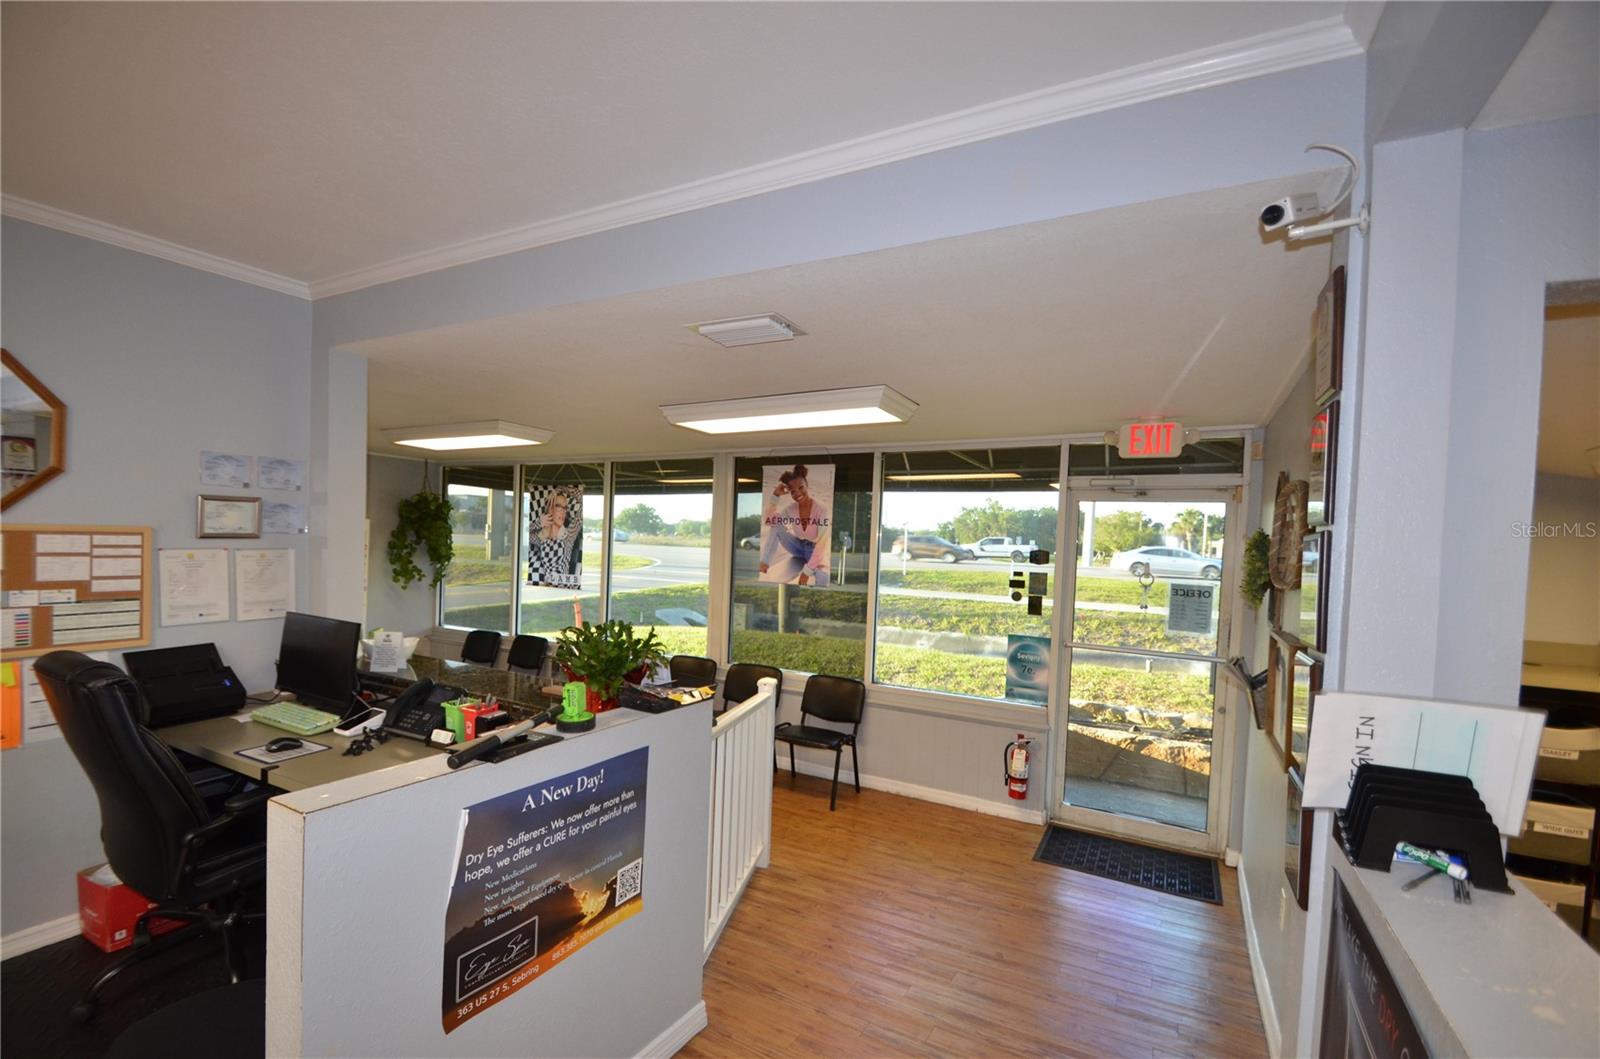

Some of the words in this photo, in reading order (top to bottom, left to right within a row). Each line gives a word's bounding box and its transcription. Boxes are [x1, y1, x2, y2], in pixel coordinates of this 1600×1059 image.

[1129, 422, 1177, 457] EXIT
[1355, 716, 1375, 740] IN
[522, 794, 536, 812] A
[540, 785, 573, 805] New
[577, 768, 604, 791] Day!
[464, 865, 493, 882] hope,
[496, 857, 510, 868] we
[512, 845, 534, 861] offer
[535, 843, 541, 851] a
[543, 831, 566, 847] CURE
[568, 825, 580, 837] for
[581, 818, 597, 834] your
[598, 805, 622, 826] painful
[465, 852, 484, 866] Dry
[486, 844, 504, 858] Eye
[506, 825, 548, 849] Sufferers:
[550, 818, 565, 830] We
[566, 812, 582, 824] now
[584, 803, 602, 817] offer
[603, 796, 620, 808] more
[620, 790, 634, 801] than
[484, 892, 499, 903] New
[485, 880, 499, 890] New
[484, 916, 496, 927] The
[457, 1002, 473, 1019] 363
[475, 993, 488, 1007] US
[489, 986, 500, 999] 27
[512, 964, 540, 986] Sebring
[1361, 952, 1377, 1006] THE
[1378, 992, 1399, 1049] DRY
